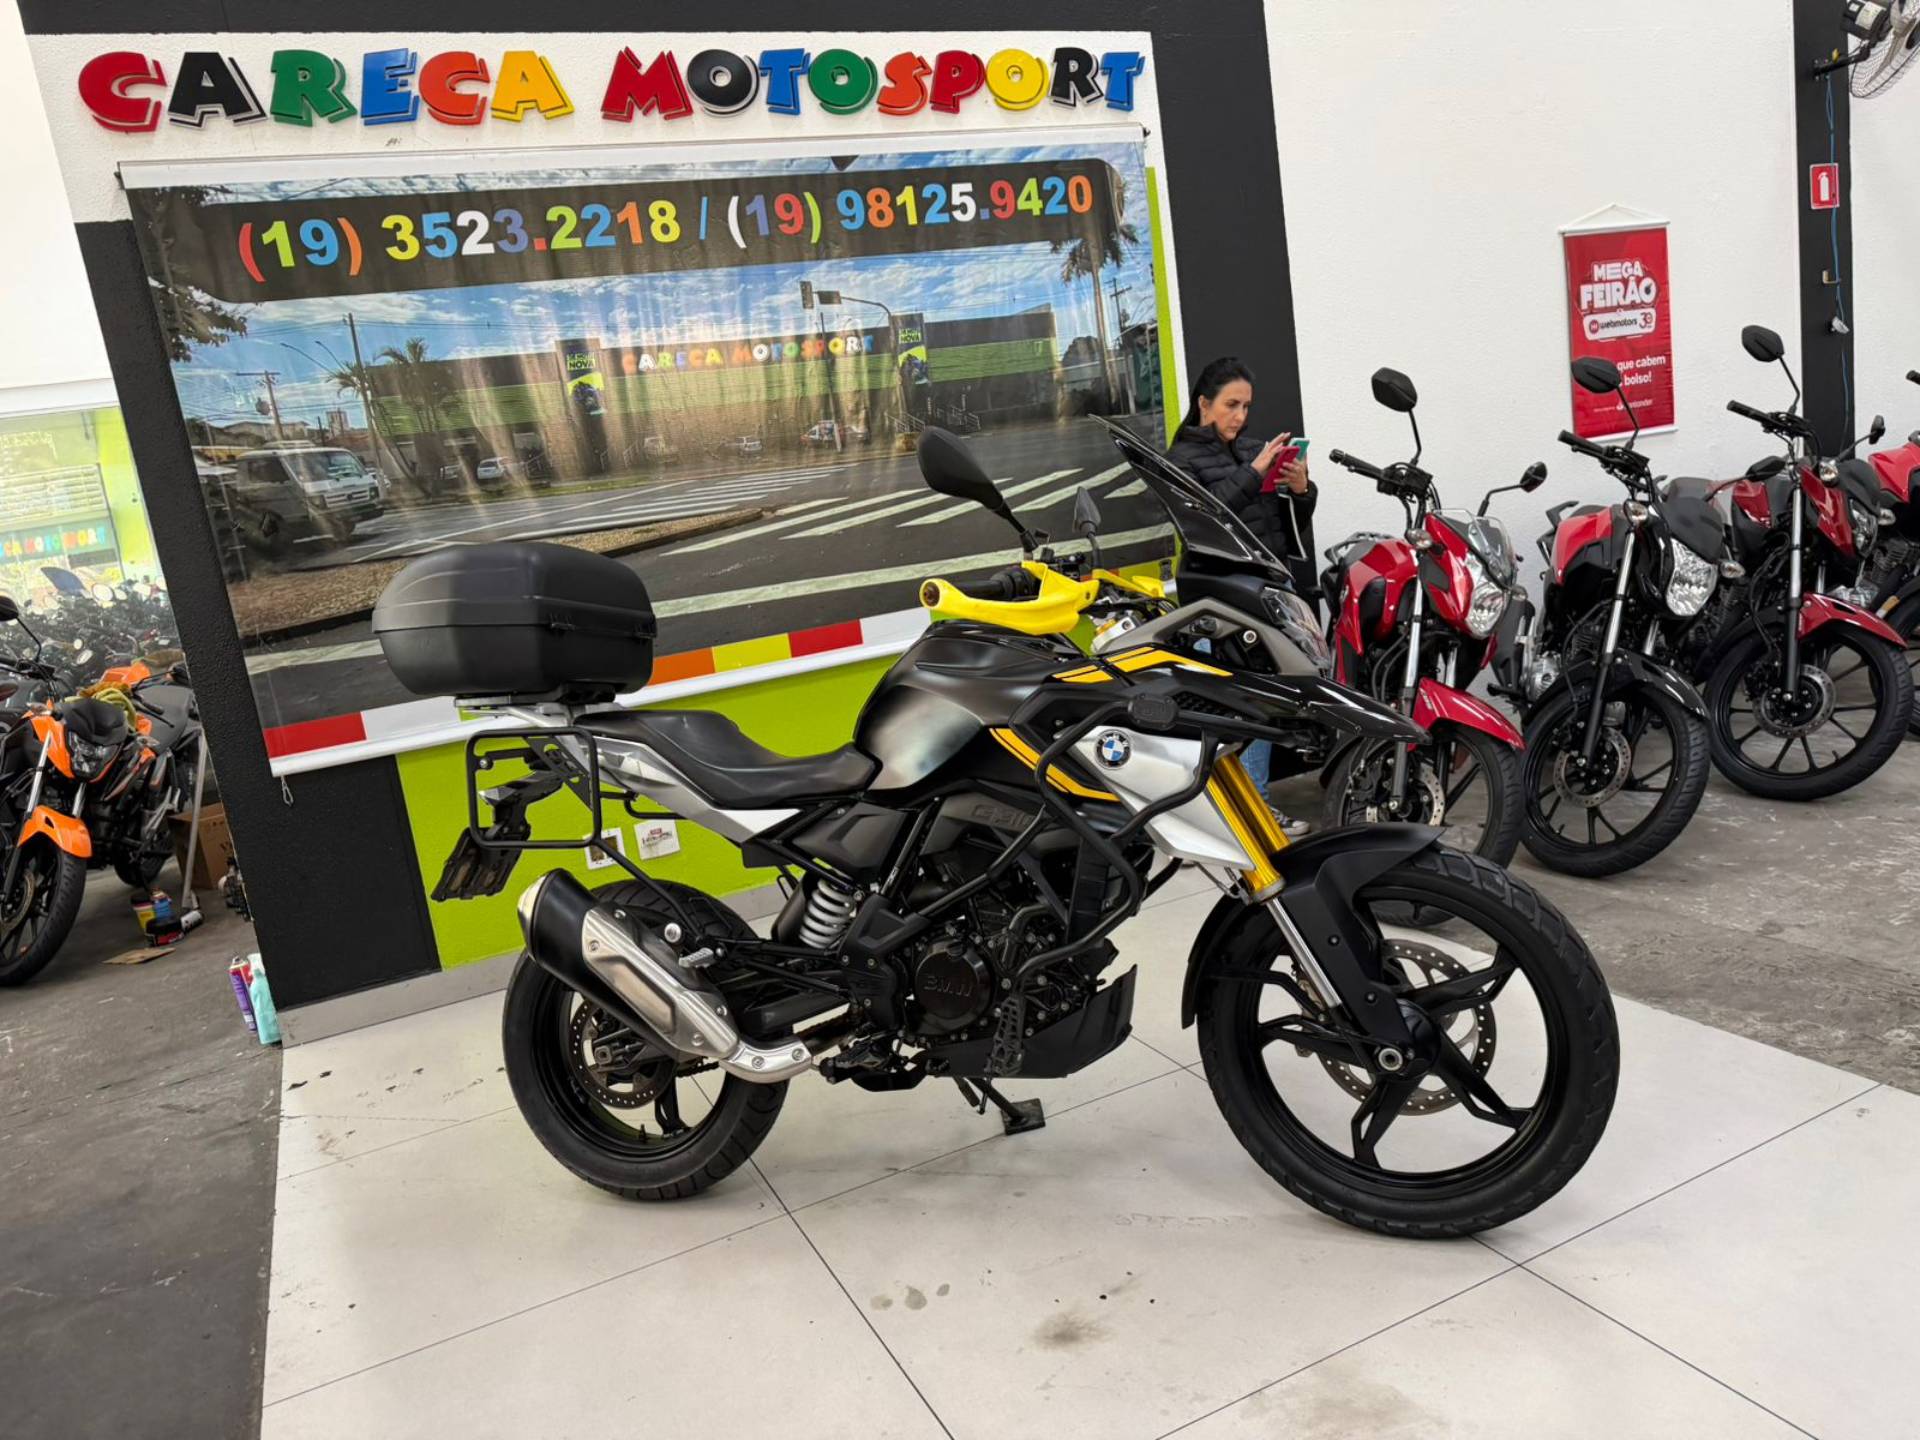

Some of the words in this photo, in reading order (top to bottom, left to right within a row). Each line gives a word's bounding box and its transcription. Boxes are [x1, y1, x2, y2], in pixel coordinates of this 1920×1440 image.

[78, 48, 575, 133] CARECA
[600, 46, 1145, 123] MOTOSPORT
[238, 217, 362, 283] (19)
[381, 199, 681, 261] 3523.2218
[728, 191, 822, 249] (19)
[836, 175, 1093, 231] 98125.9420
[1593, 260, 1643, 282] MEGA
[1580, 276, 1657, 310] FEIRÃO
[1600, 317, 1638, 330] webmotors
[622, 348, 724, 375] CARECA
[1616, 360, 1634, 373] que
[1636, 355, 1666, 369] cabem
[1624, 370, 1652, 386] bolso!
